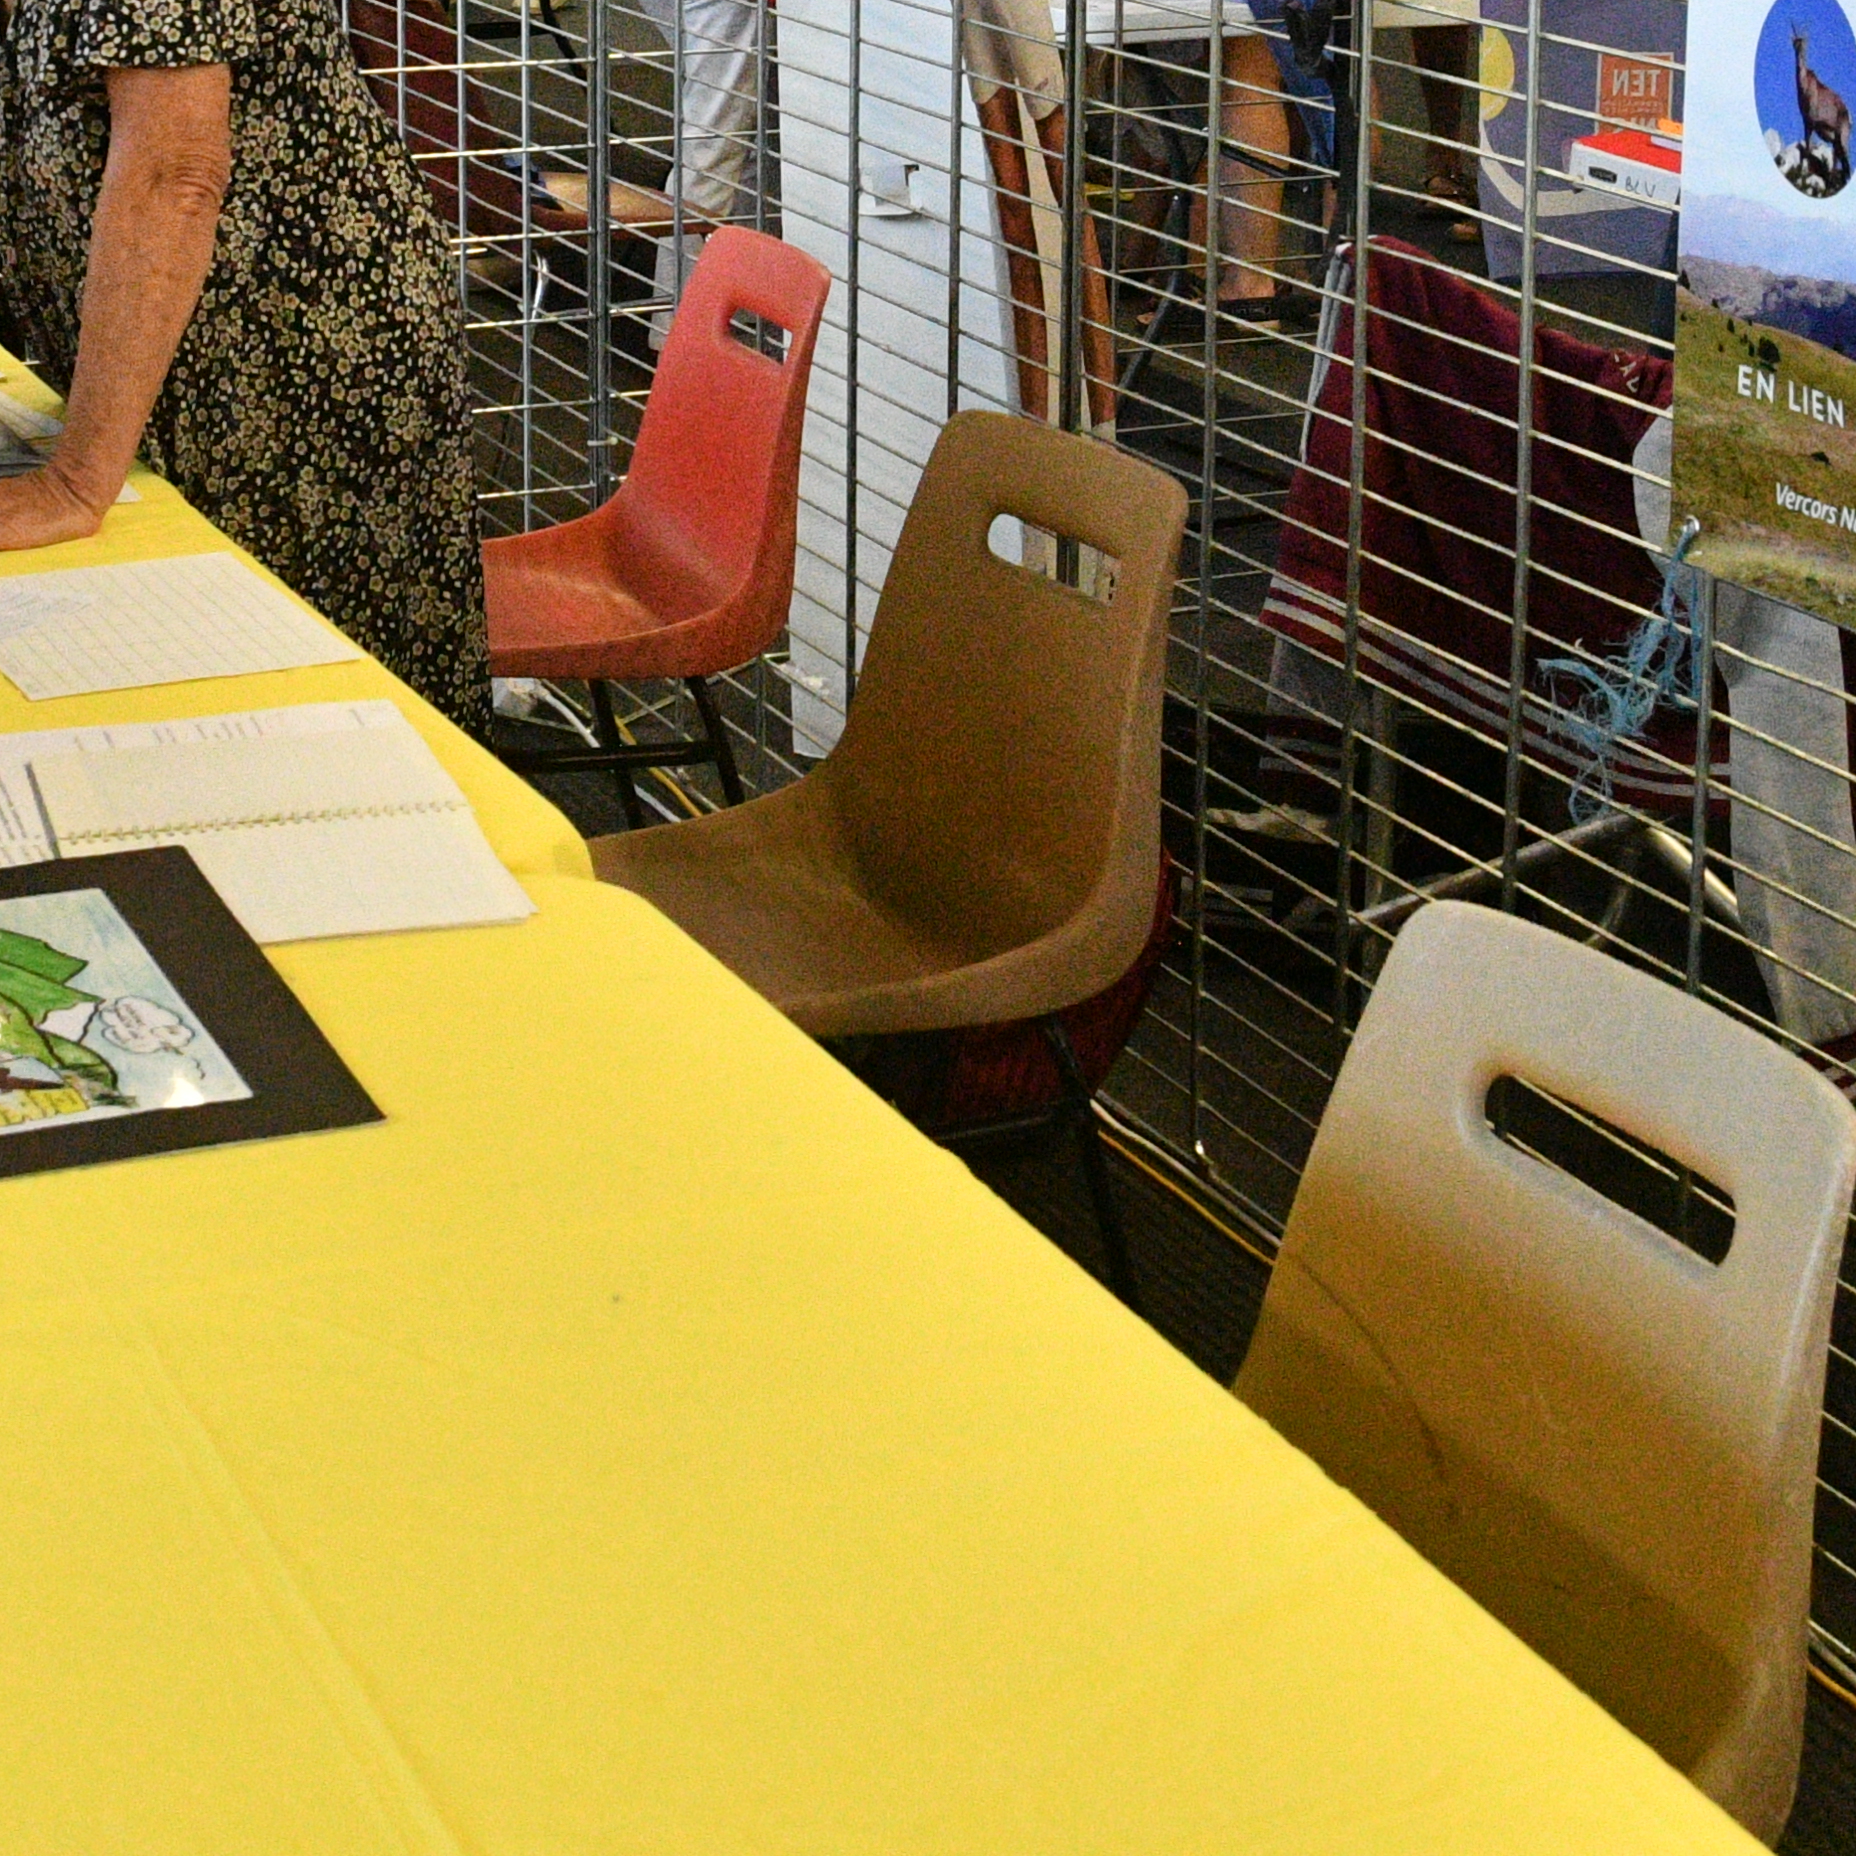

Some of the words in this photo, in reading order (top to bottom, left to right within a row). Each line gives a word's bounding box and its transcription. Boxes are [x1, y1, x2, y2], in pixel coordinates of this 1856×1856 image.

[1736, 363, 1776, 405] EN
[1787, 381, 1846, 428] LIEN
[1775, 482, 1836, 528] Vercors
